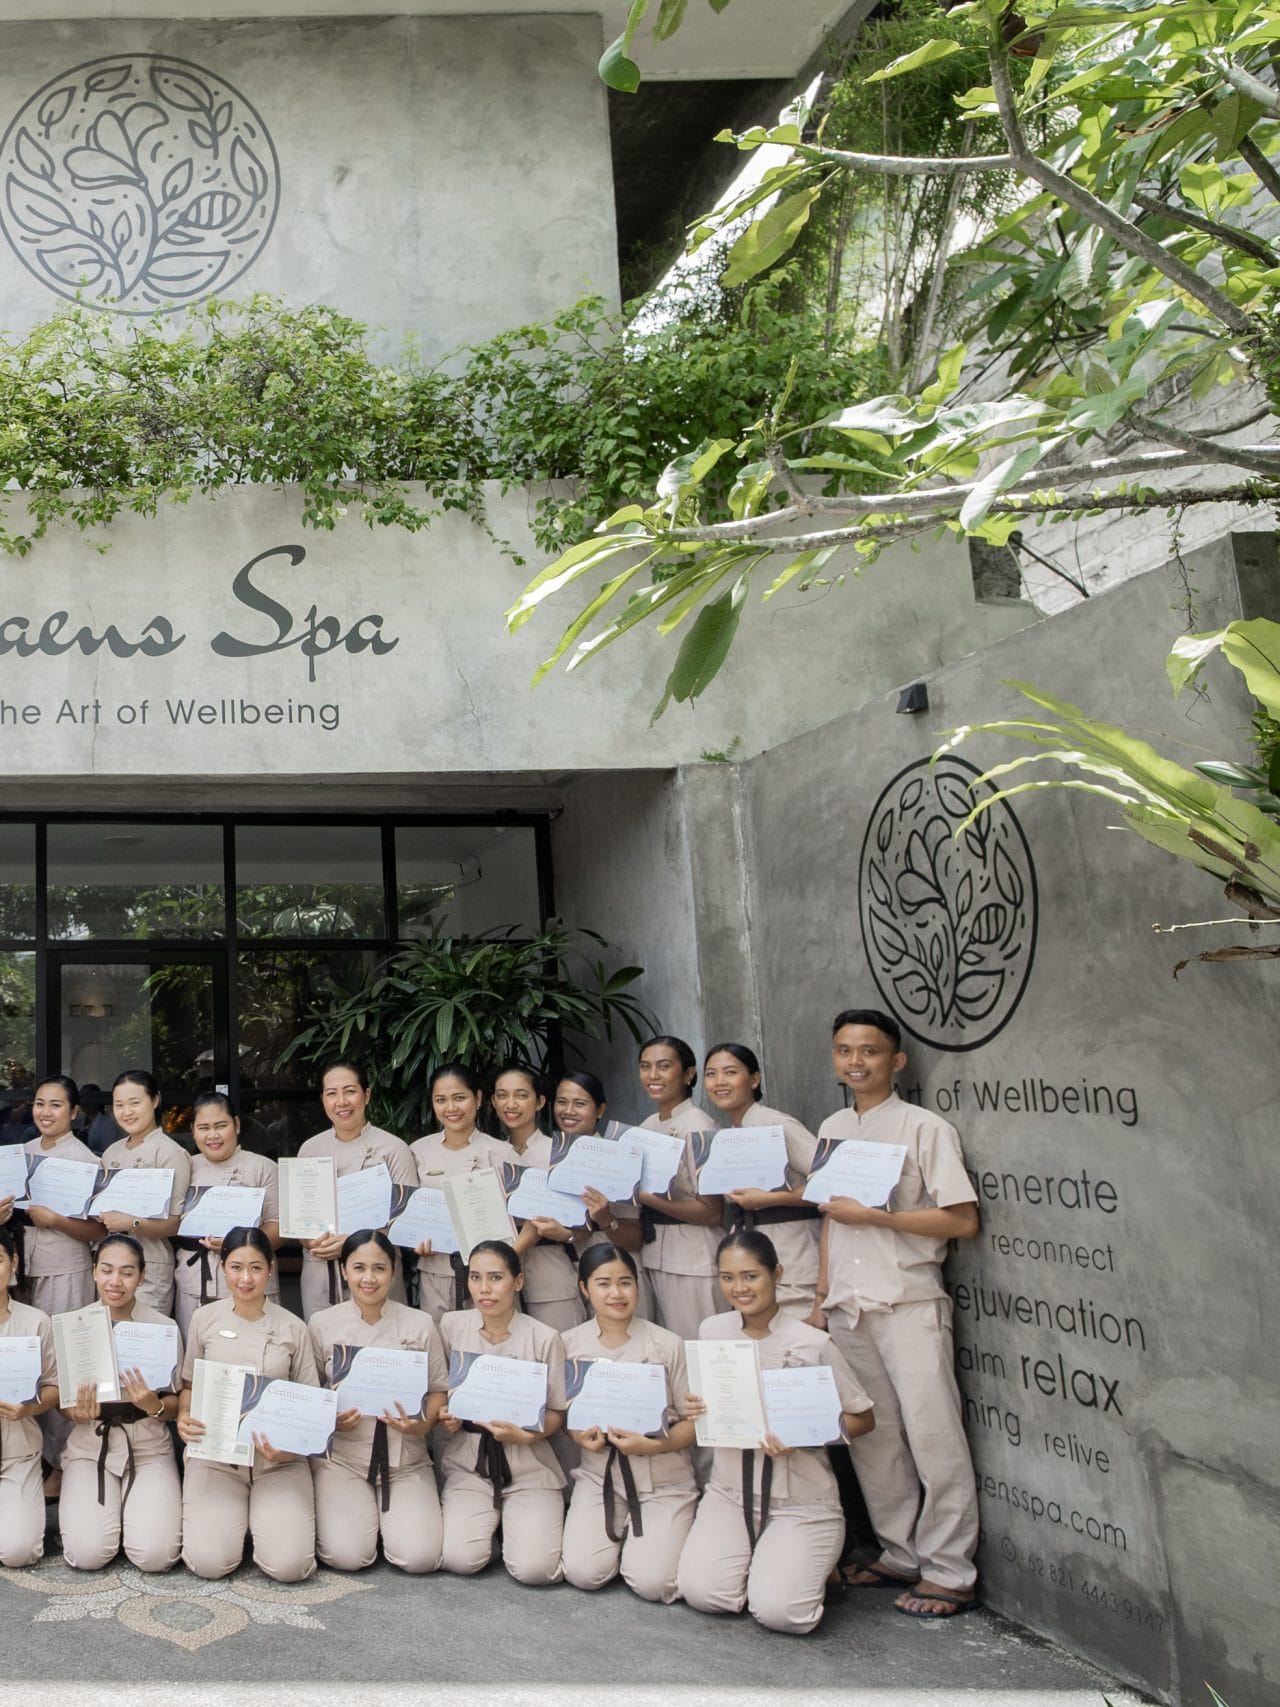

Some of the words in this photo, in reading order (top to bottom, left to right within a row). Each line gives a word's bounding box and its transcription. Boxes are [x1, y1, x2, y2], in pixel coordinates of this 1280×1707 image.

[211, 544, 400, 682] Spa
[56, 699, 103, 725] Art
[116, 699, 151, 725] of
[166, 699, 341, 731] Wellbeing
[936, 1079, 962, 1113] of
[973, 1078, 1140, 1127] Wellbeing
[991, 1234, 1115, 1272] reconnect
[1021, 1353, 1123, 1416] relax
[1044, 1432, 1110, 1473] relive
